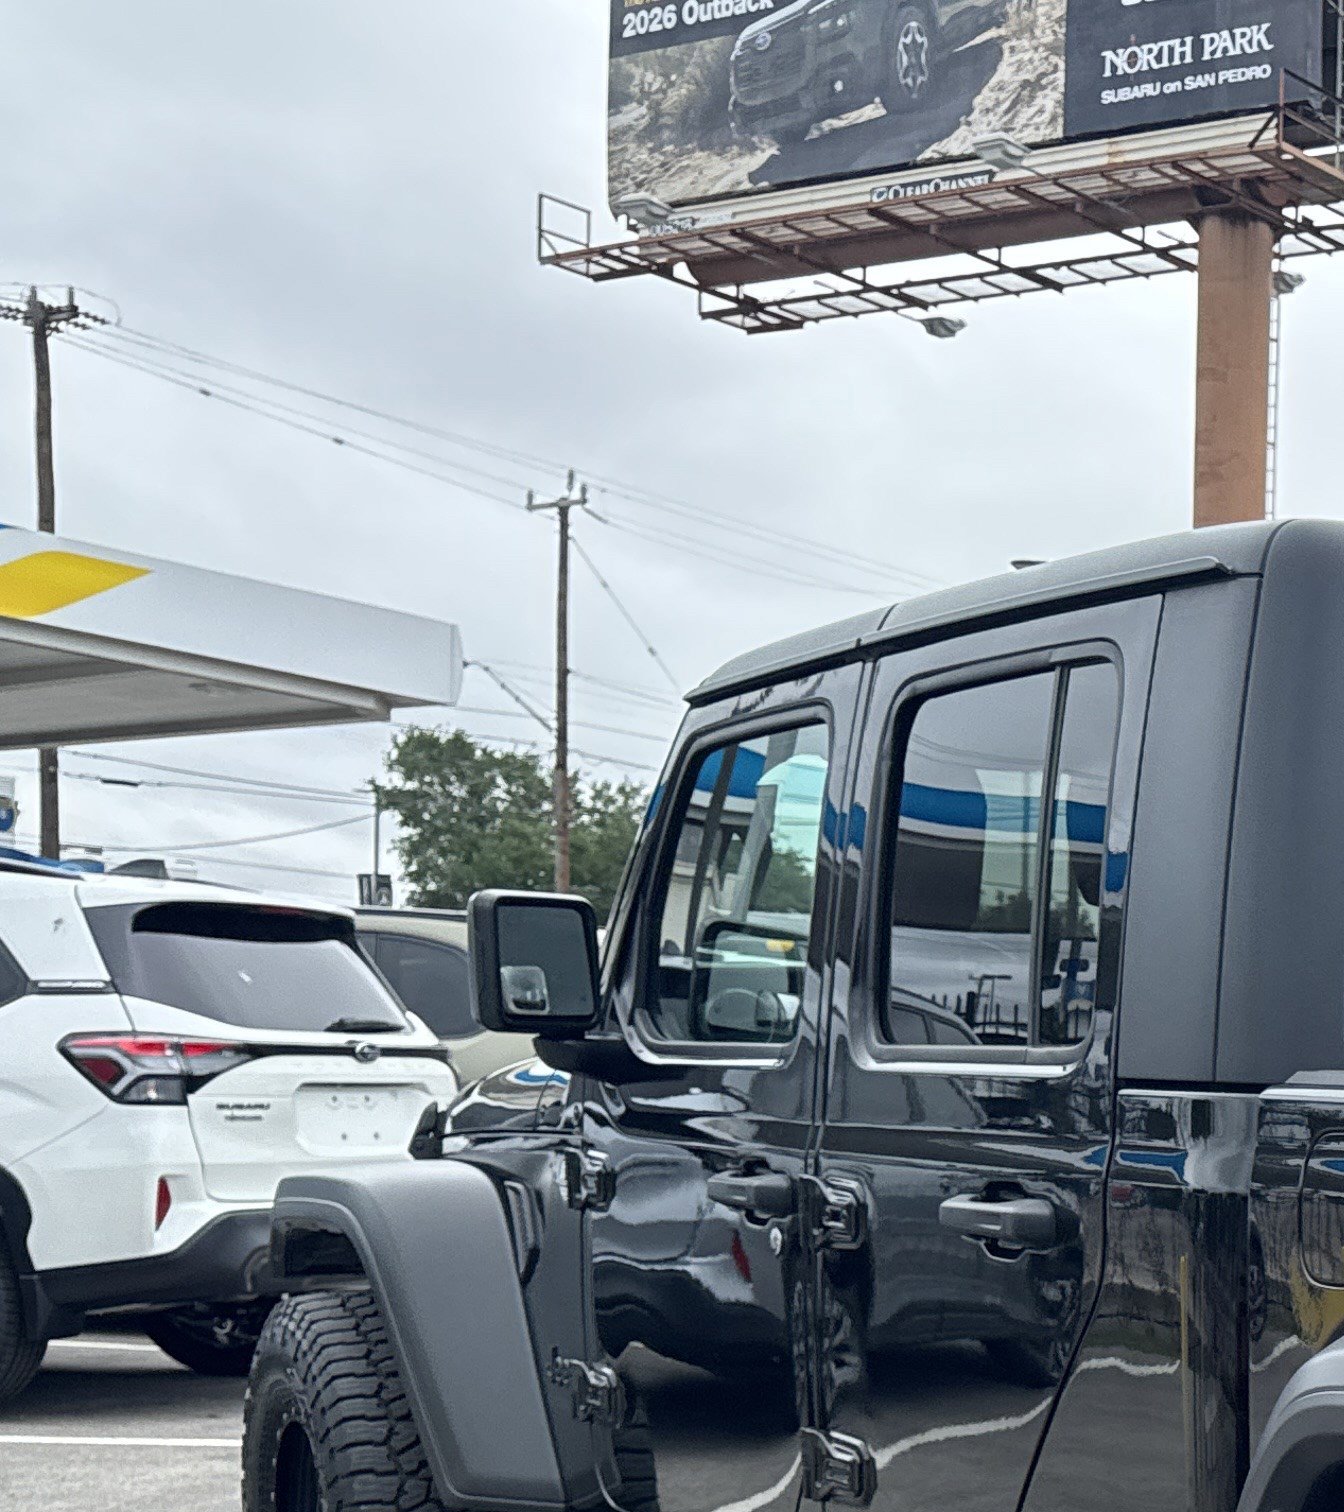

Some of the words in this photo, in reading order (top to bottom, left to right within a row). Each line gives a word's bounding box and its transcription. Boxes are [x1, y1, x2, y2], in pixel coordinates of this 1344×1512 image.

[622, 4, 678, 38] 2026
[1101, 35, 1194, 77] NORTH
[1200, 22, 1274, 61] PARK
[1100, 82, 1161, 104] SUBARU
[1163, 81, 1182, 94] on
[1184, 72, 1216, 90] SAN
[1218, 63, 1272, 85] PEDRO
